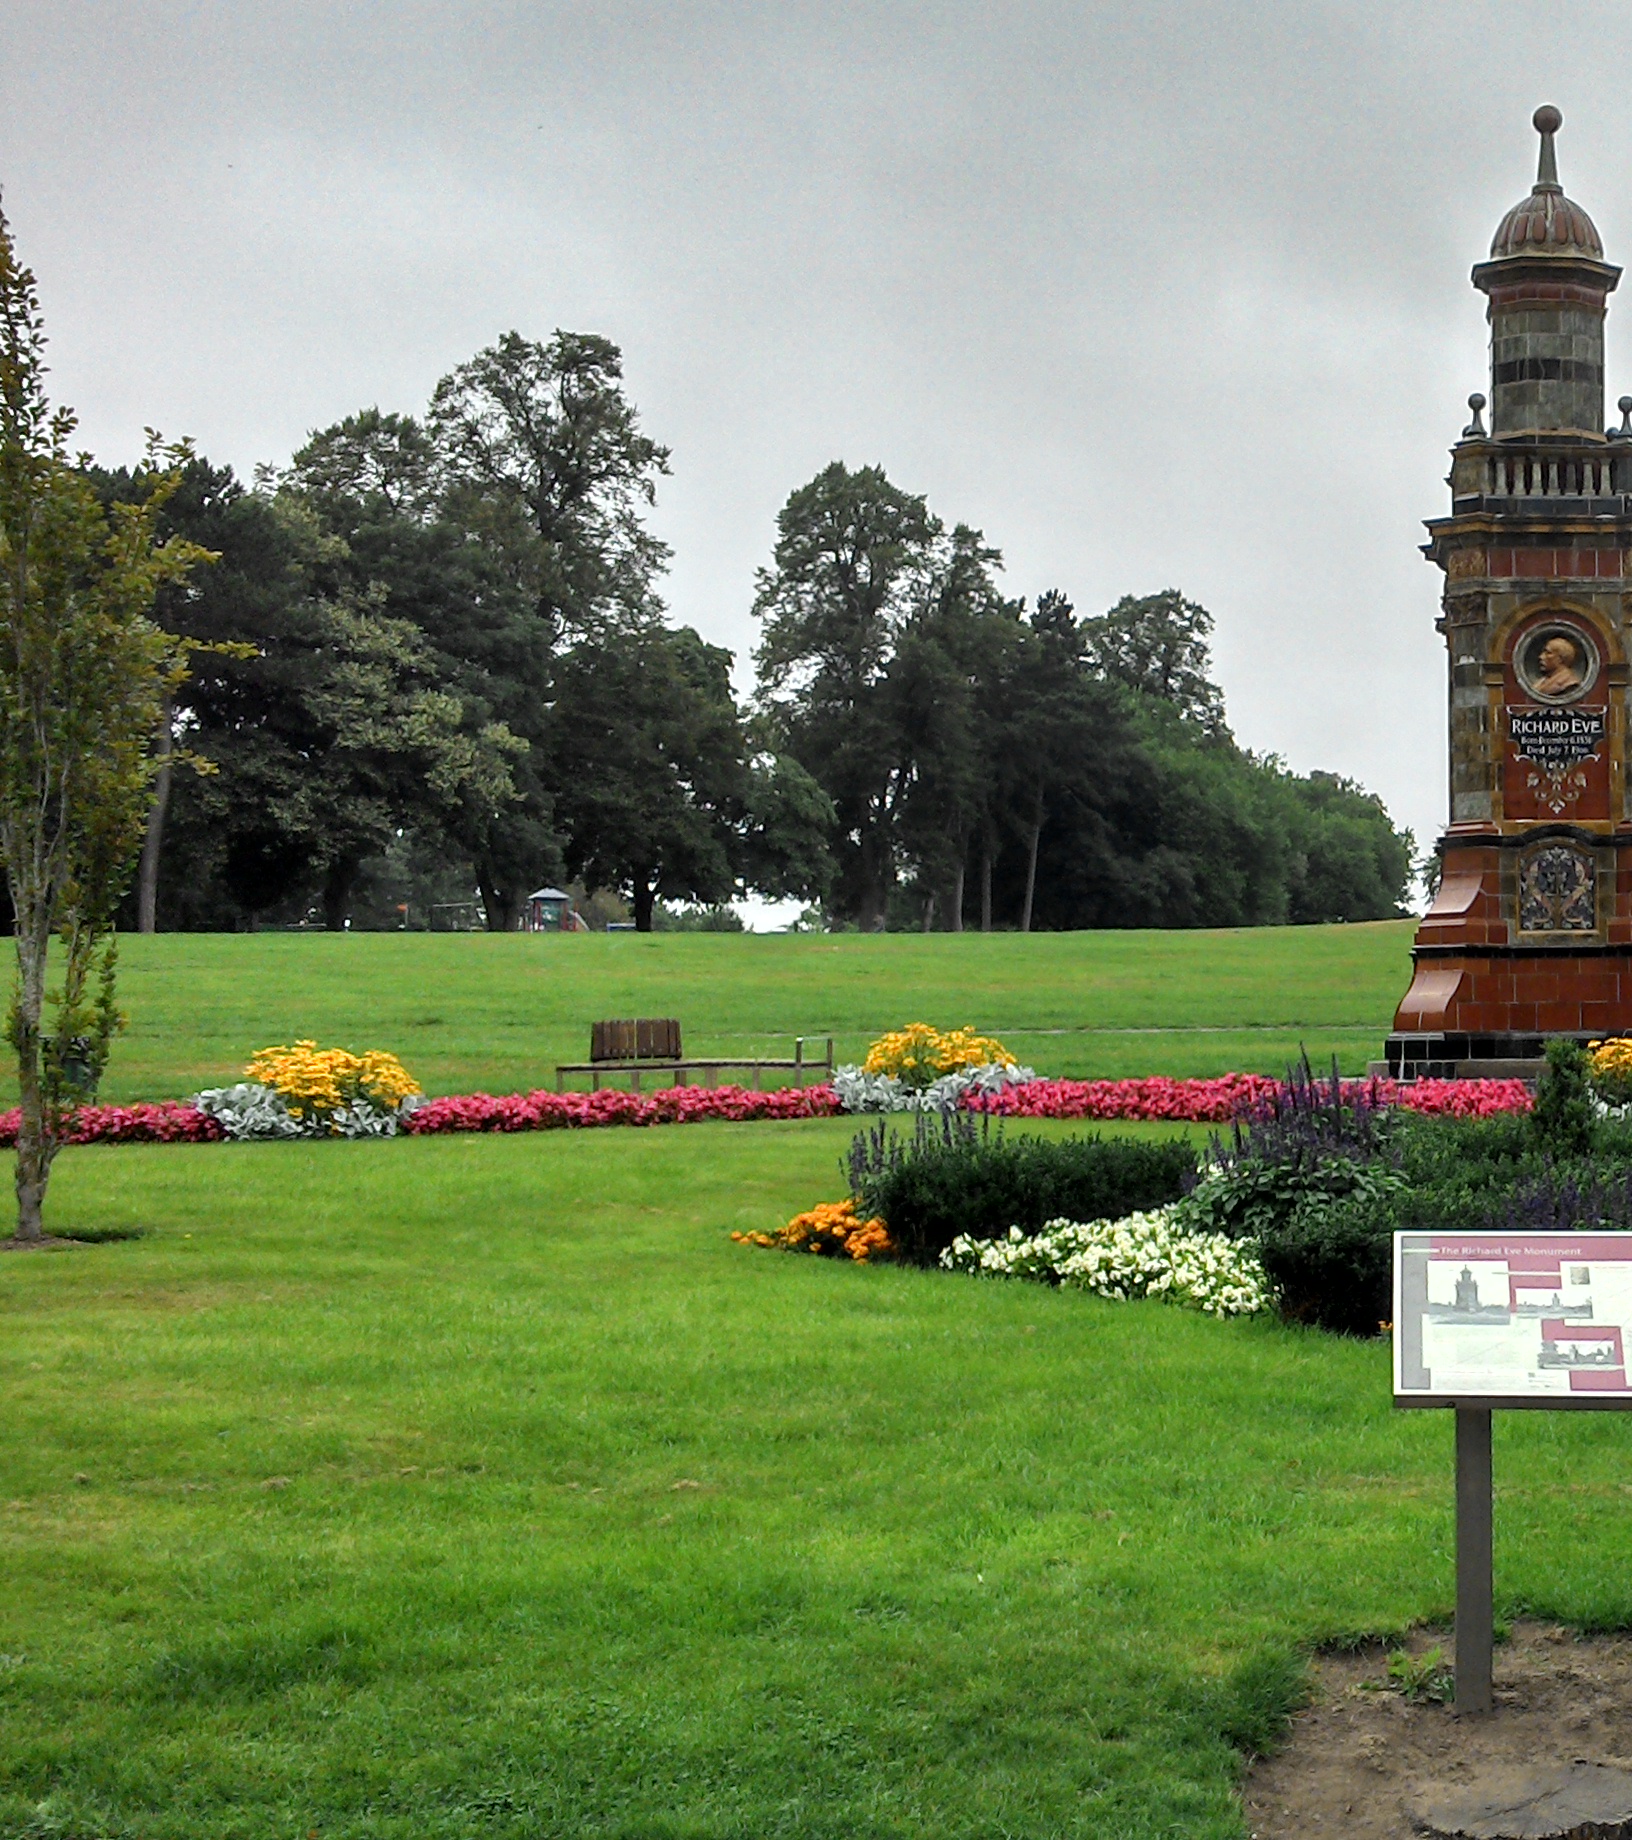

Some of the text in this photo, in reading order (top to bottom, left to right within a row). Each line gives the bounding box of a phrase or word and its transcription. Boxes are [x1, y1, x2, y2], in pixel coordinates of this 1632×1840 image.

[1512, 718, 1602, 734] RICHARD EVE
[1527, 745, 1545, 754] Died
[1441, 1247, 1582, 1255] The Richard Eve Monument
